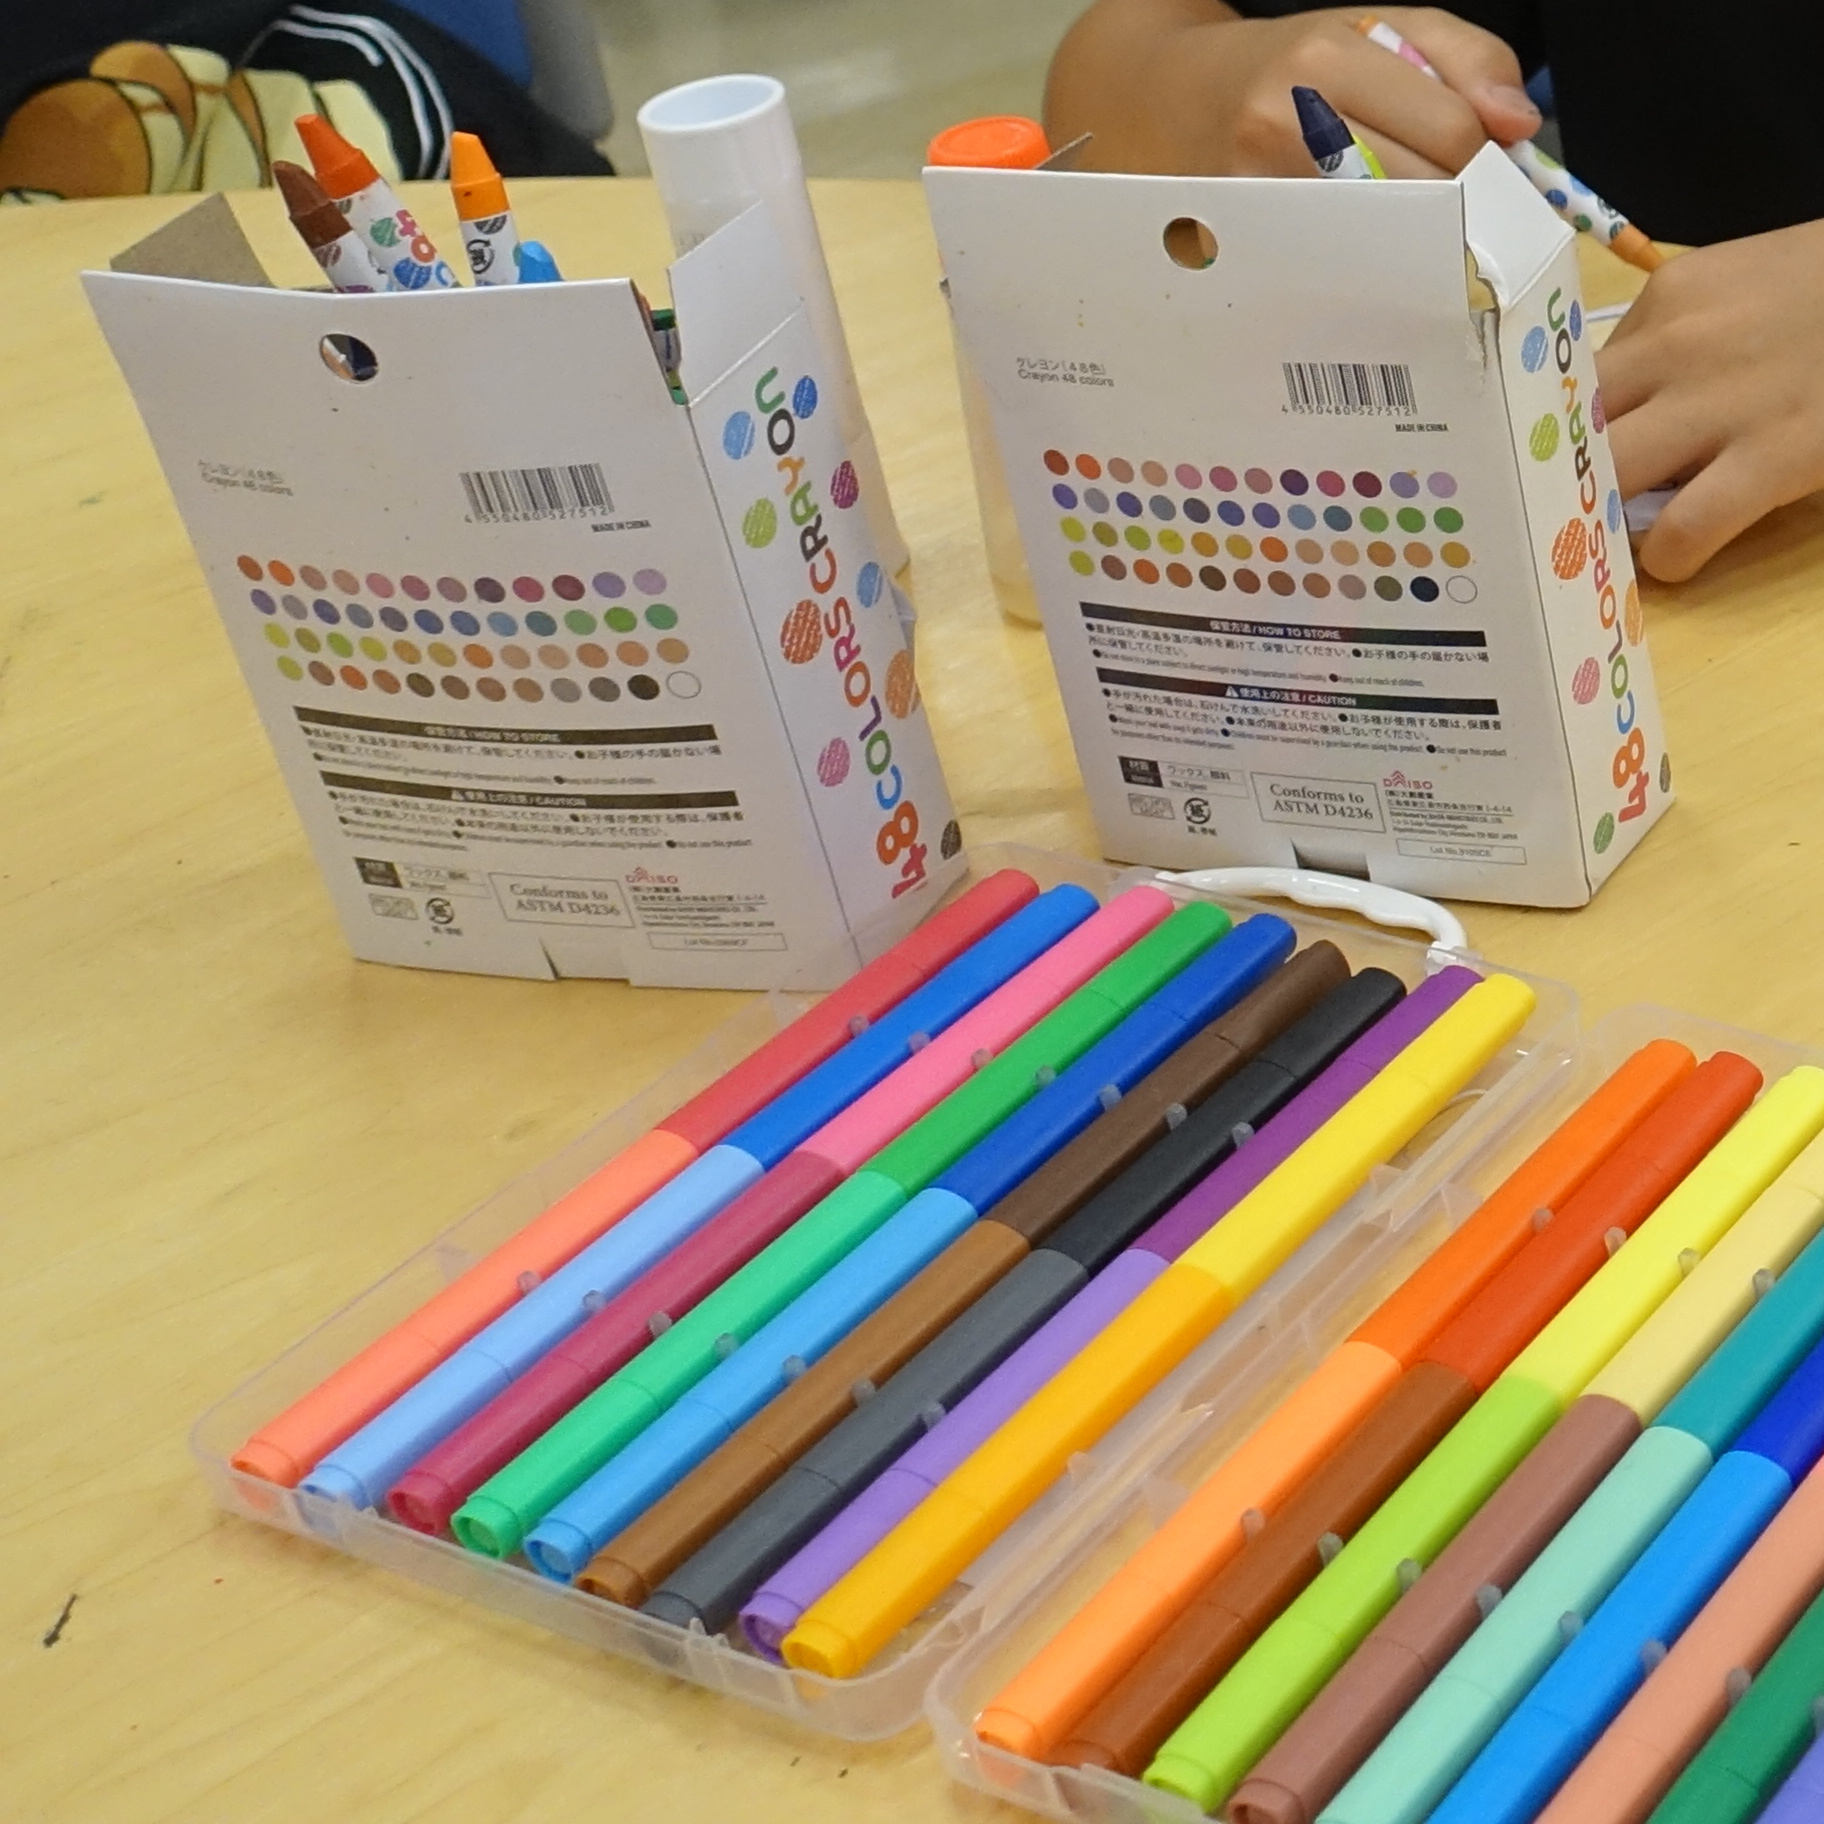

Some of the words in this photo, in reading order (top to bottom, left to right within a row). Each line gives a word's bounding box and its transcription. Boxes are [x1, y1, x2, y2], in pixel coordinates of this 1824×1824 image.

[1017, 369, 1059, 383] Crayon
[1062, 374, 1077, 384] 48
[1079, 376, 1115, 387] colors
[1395, 423, 1416, 433] MADE
[1417, 424, 1426, 433] IN
[1426, 423, 1449, 433] CHINA
[1258, 625, 1284, 636] HOW
[1287, 628, 1302, 637] TO
[1304, 629, 1342, 640] STORE
[1308, 694, 1357, 707] CAUTION
[1383, 770, 1433, 790] DAISO
[1270, 783, 1345, 802] Conforms
[1348, 792, 1364, 803] to
[1274, 799, 1319, 815] ASTM
[1324, 804, 1373, 819] D4236
[510, 883, 588, 899] Conforms
[591, 890, 608, 900] to
[517, 899, 563, 913] ASTM
[567, 902, 620, 915] D4236
